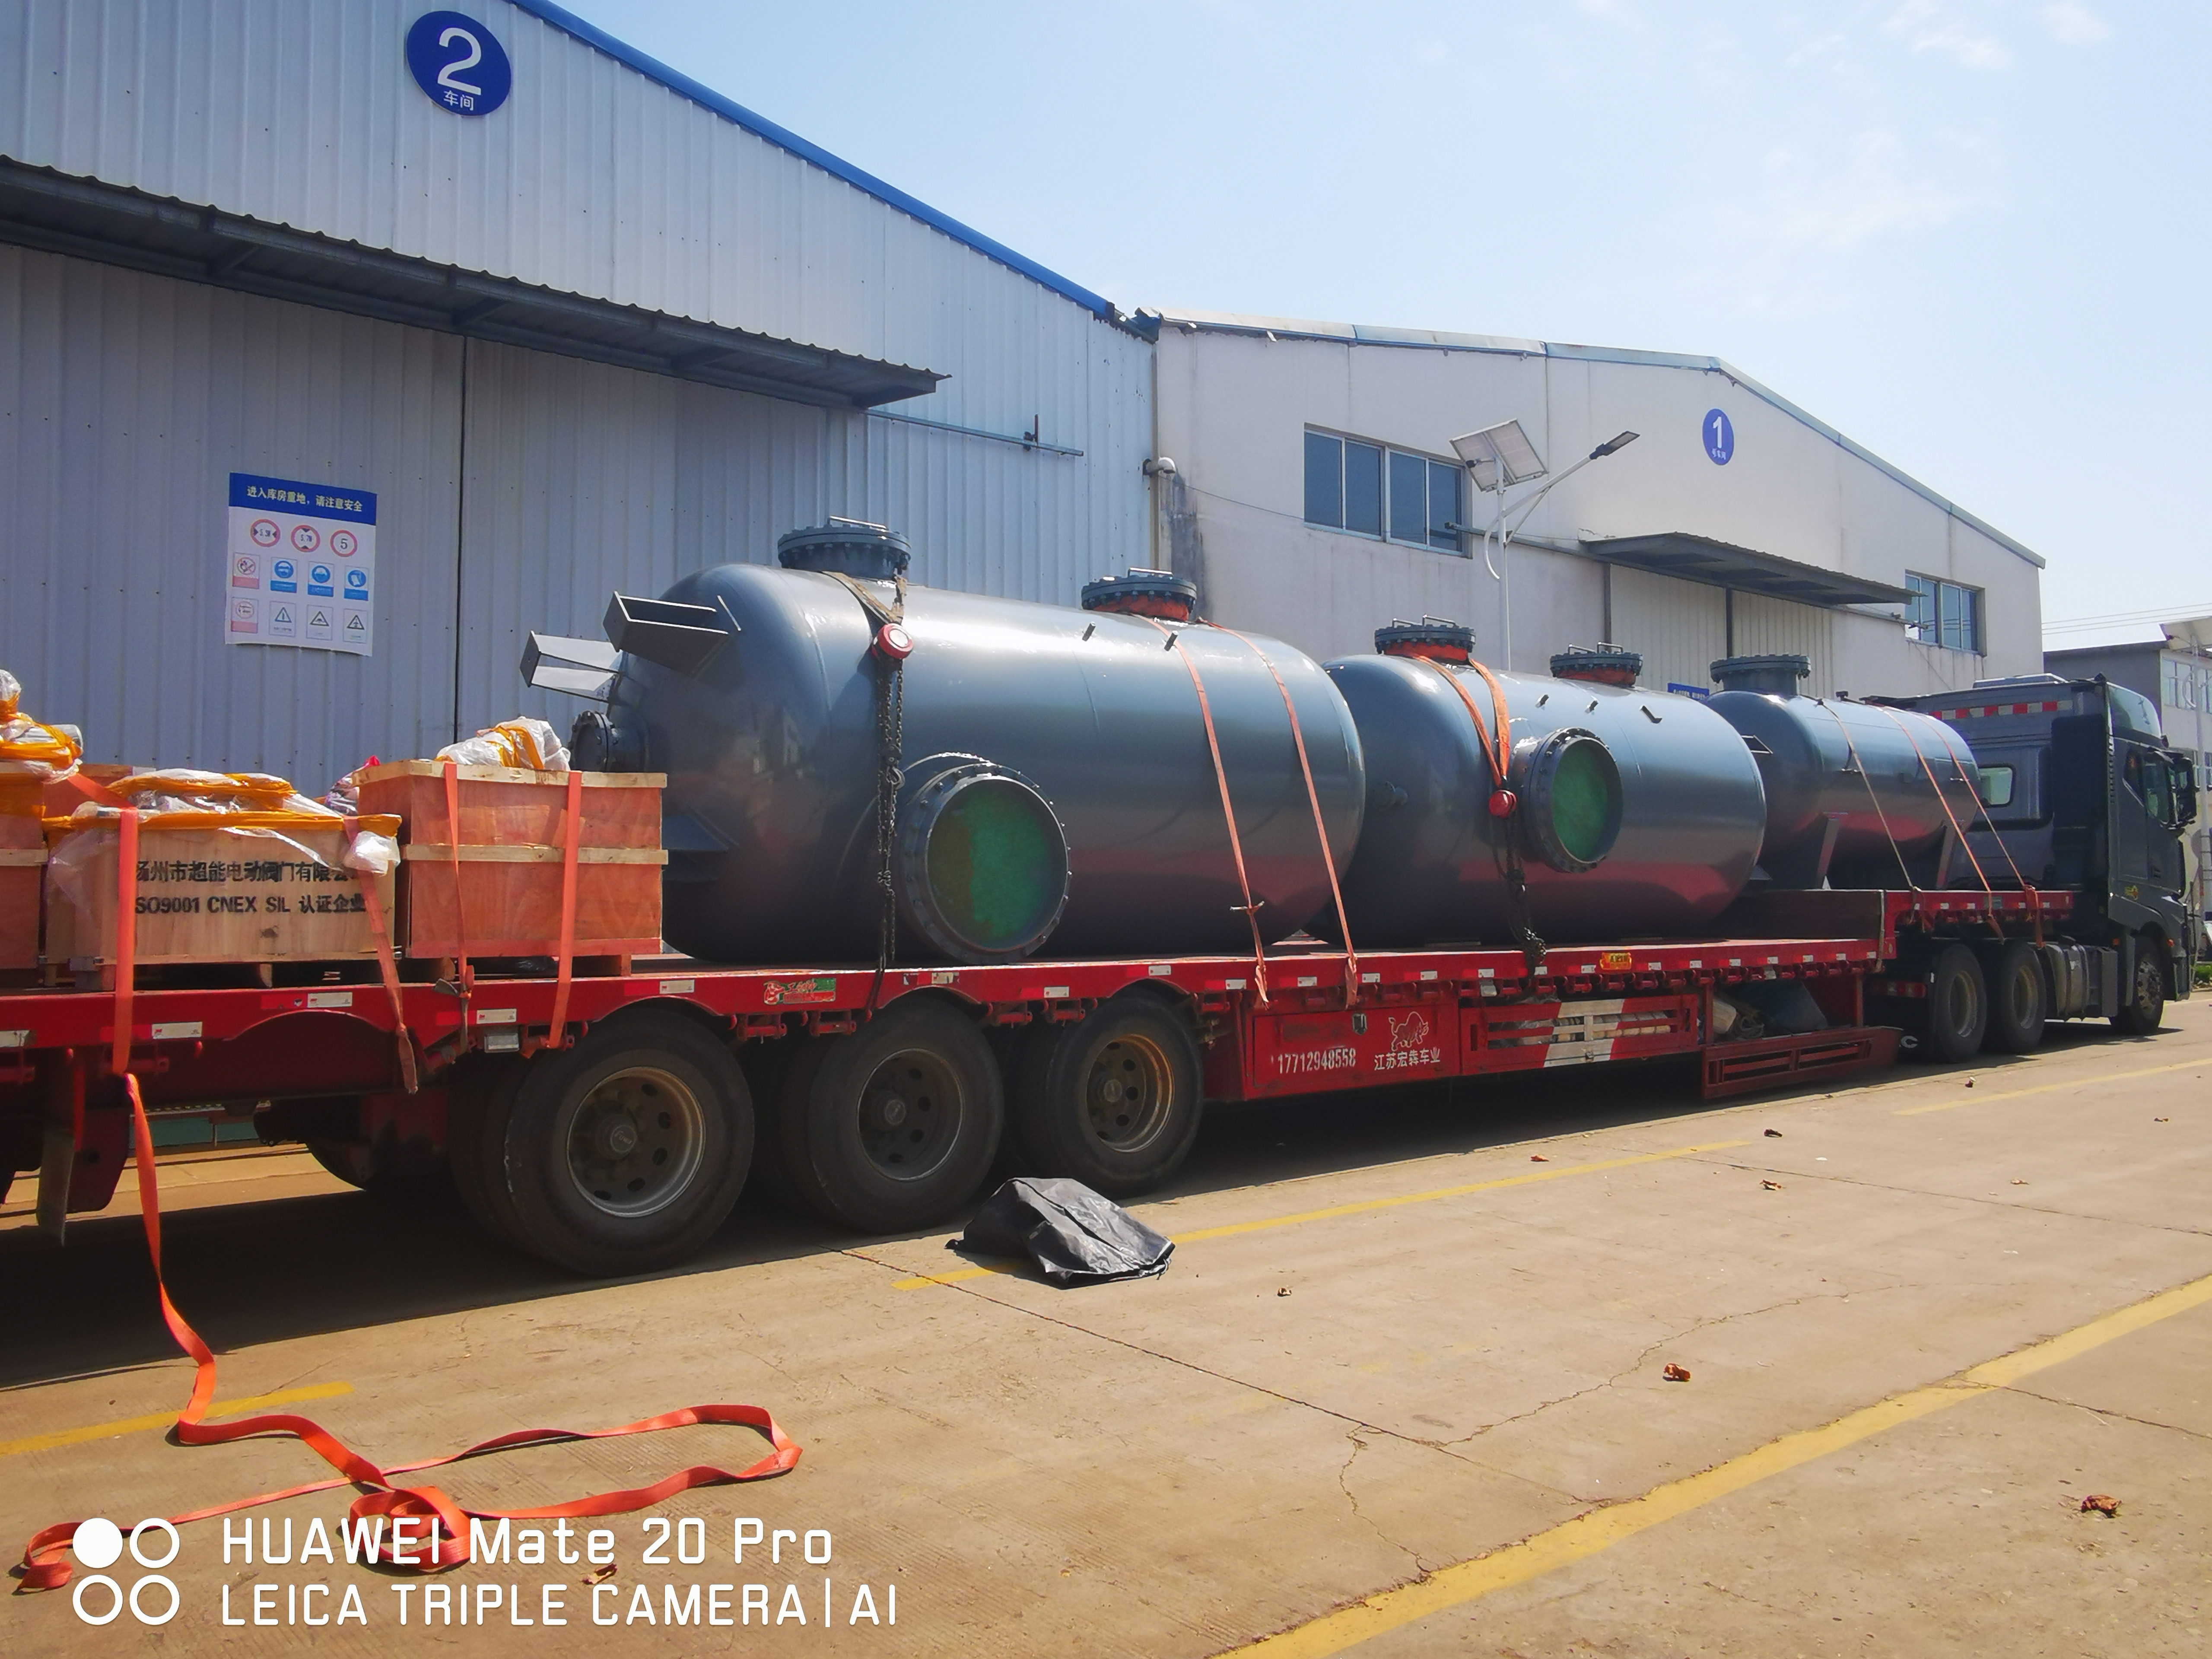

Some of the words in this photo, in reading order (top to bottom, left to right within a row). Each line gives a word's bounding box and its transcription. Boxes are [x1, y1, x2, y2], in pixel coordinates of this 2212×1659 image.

[438, 27, 481, 95] 2
[443, 90, 474, 111] 车间
[1713, 416, 1722, 448] 1
[340, 538, 348, 550] 5
[134, 896, 200, 914] SO9001
[207, 896, 257, 914] CNEX
[265, 896, 291, 913] SIL
[1278, 1047, 1356, 1074] 17712948558
